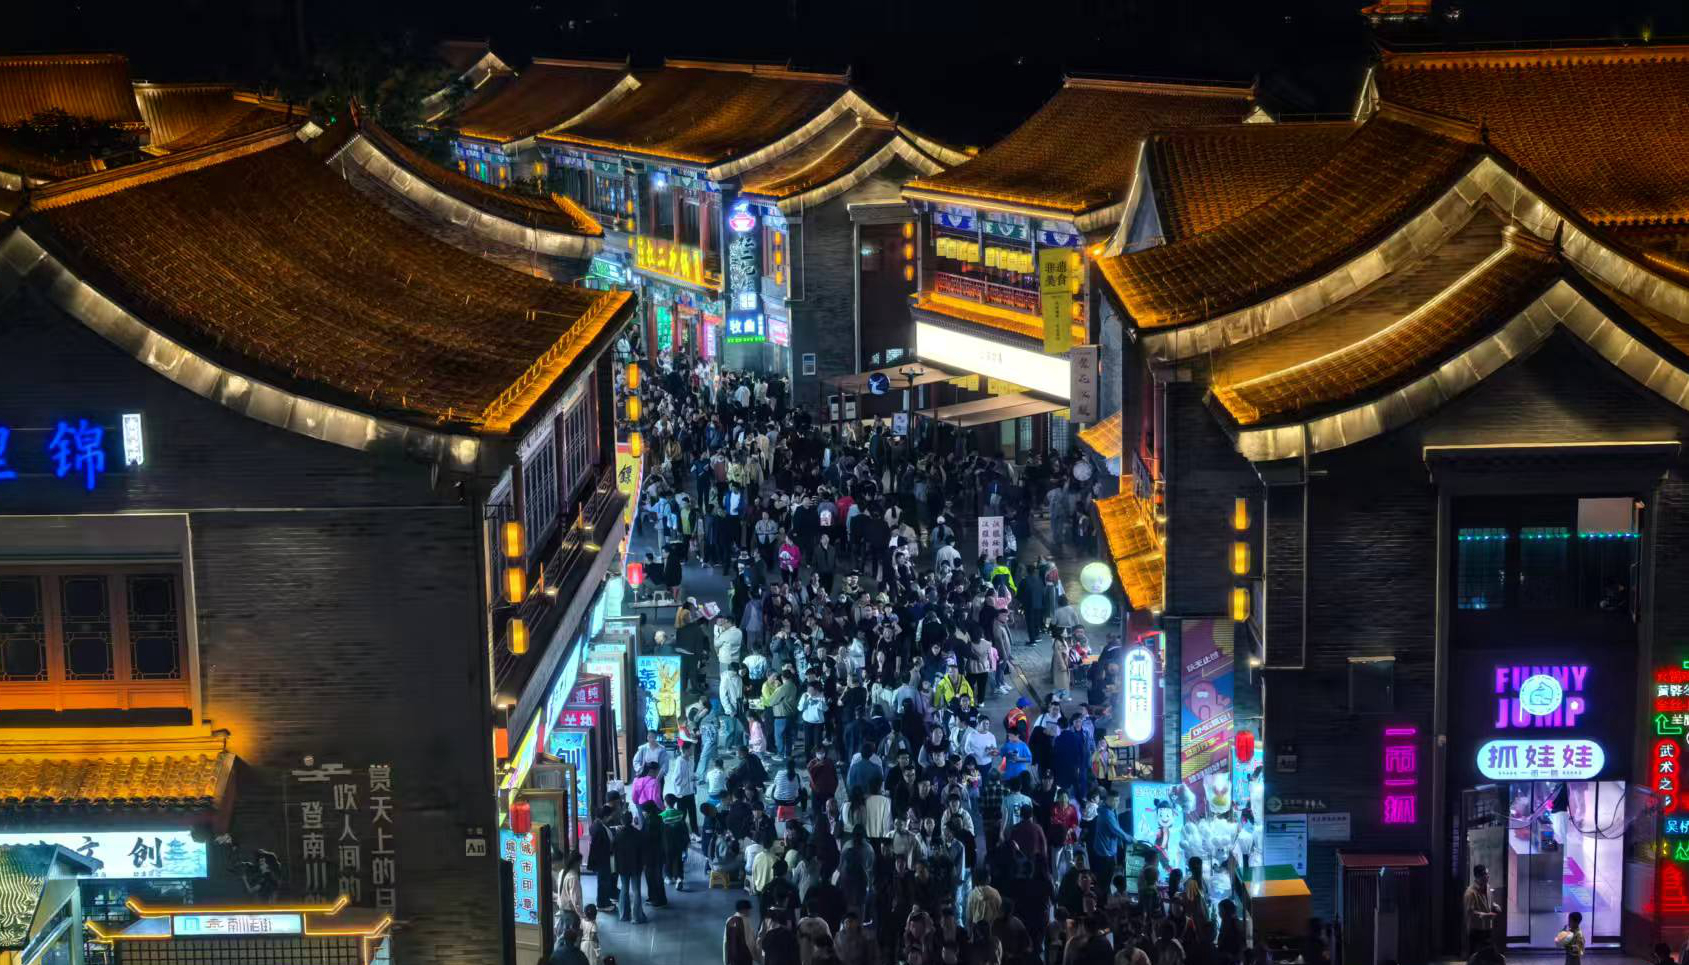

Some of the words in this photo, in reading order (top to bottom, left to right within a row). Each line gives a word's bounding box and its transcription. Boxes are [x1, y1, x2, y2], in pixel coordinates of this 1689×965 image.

[1487, 744, 1593, 768] 抓娃娃
[301, 801, 327, 904] 登南川
